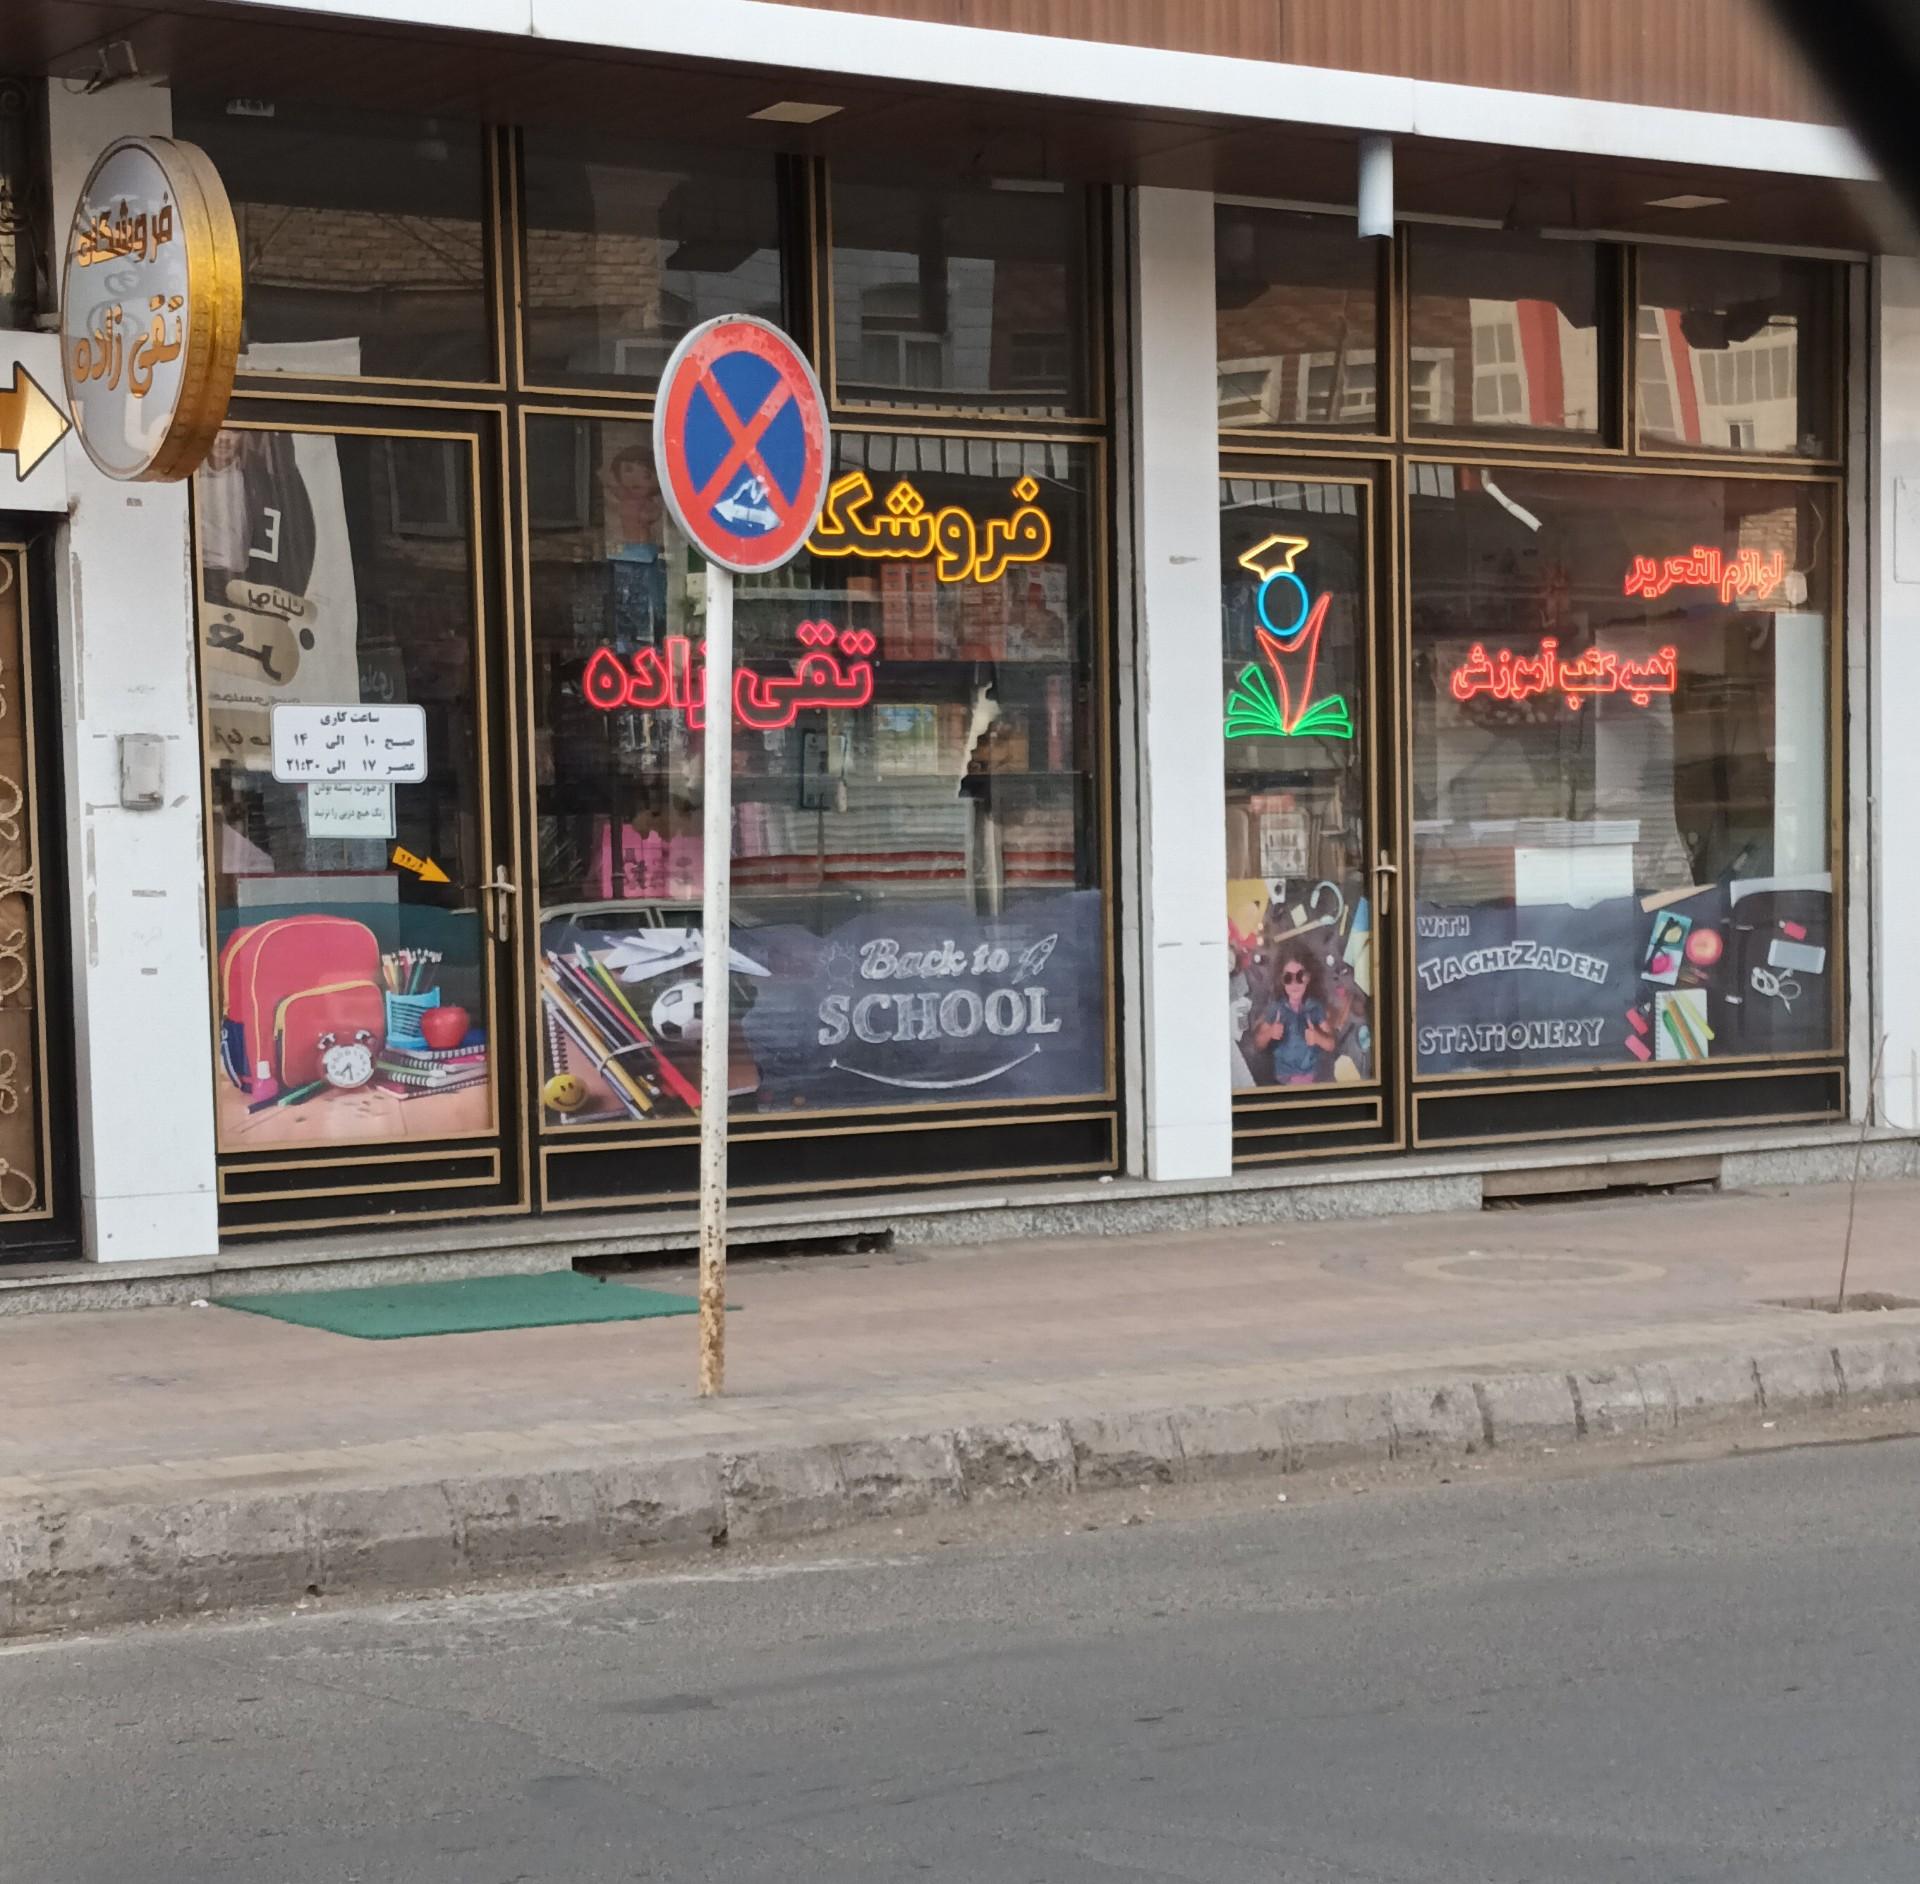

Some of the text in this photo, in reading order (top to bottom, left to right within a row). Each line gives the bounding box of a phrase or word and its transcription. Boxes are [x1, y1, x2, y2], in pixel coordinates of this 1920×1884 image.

[73, 294, 183, 398] تقی زاده
[804, 470, 1052, 583] فروشگ
[1625, 547, 1784, 604] لوازم التحریر
[734, 619, 877, 731] تقی
[320, 712, 380, 727] ساعت کاری
[326, 735, 345, 750] الی
[365, 734, 376, 747] ۱۰
[385, 739, 415, 750] صبح
[327, 760, 346, 775] الی
[363, 759, 376, 771] ۱۷
[386, 764, 415, 775] عصر
[860, 938, 1010, 980] Back to
[818, 987, 1063, 1046] SCHOOL
